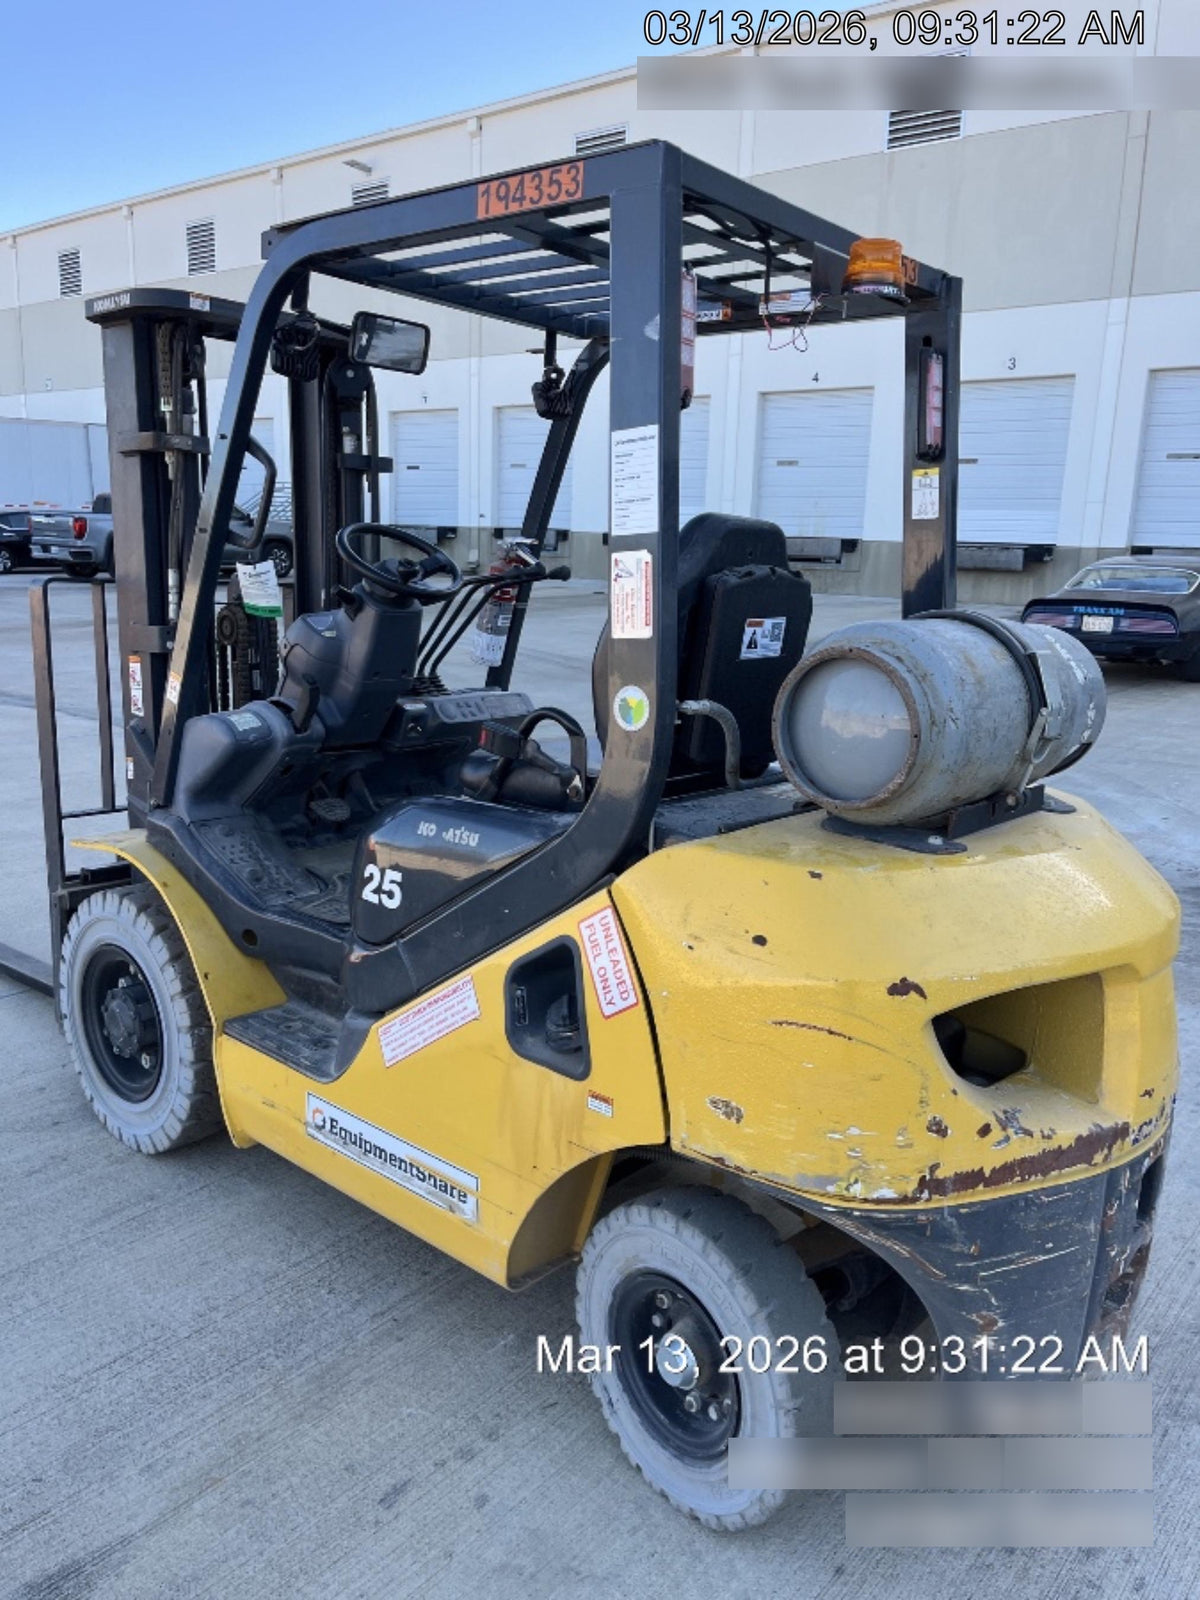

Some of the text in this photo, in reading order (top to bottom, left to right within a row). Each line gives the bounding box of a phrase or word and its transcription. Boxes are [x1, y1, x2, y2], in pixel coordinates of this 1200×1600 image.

[480, 162, 582, 216] 194353
[811, 371, 820, 384] 4
[1007, 356, 1017, 371] 3
[361, 863, 403, 910] 25
[584, 922, 616, 1007] FUEL ONLY
[599, 914, 631, 1002] UNLEADED
